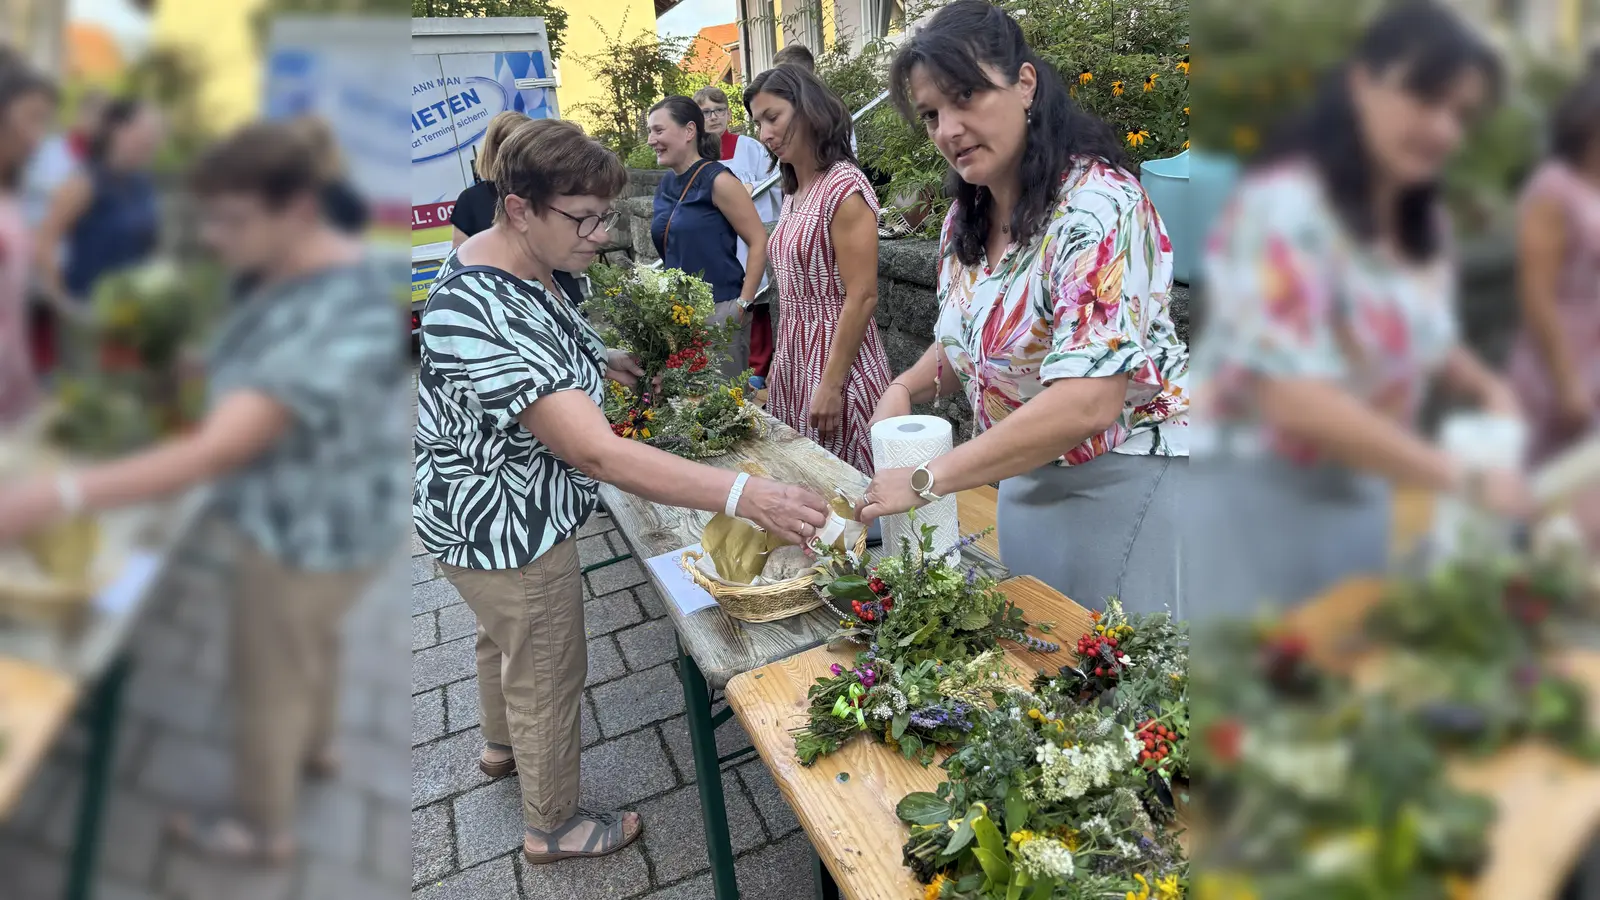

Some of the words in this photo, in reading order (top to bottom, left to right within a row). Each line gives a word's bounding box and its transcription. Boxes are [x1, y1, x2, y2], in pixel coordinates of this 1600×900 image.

[412, 80, 435, 96] ANN
[437, 76, 461, 87] MAN
[412, 88, 481, 133] IETEN
[422, 124, 455, 142] Termine
[457, 108, 489, 128] sichern!
[412, 210, 432, 225] L:
